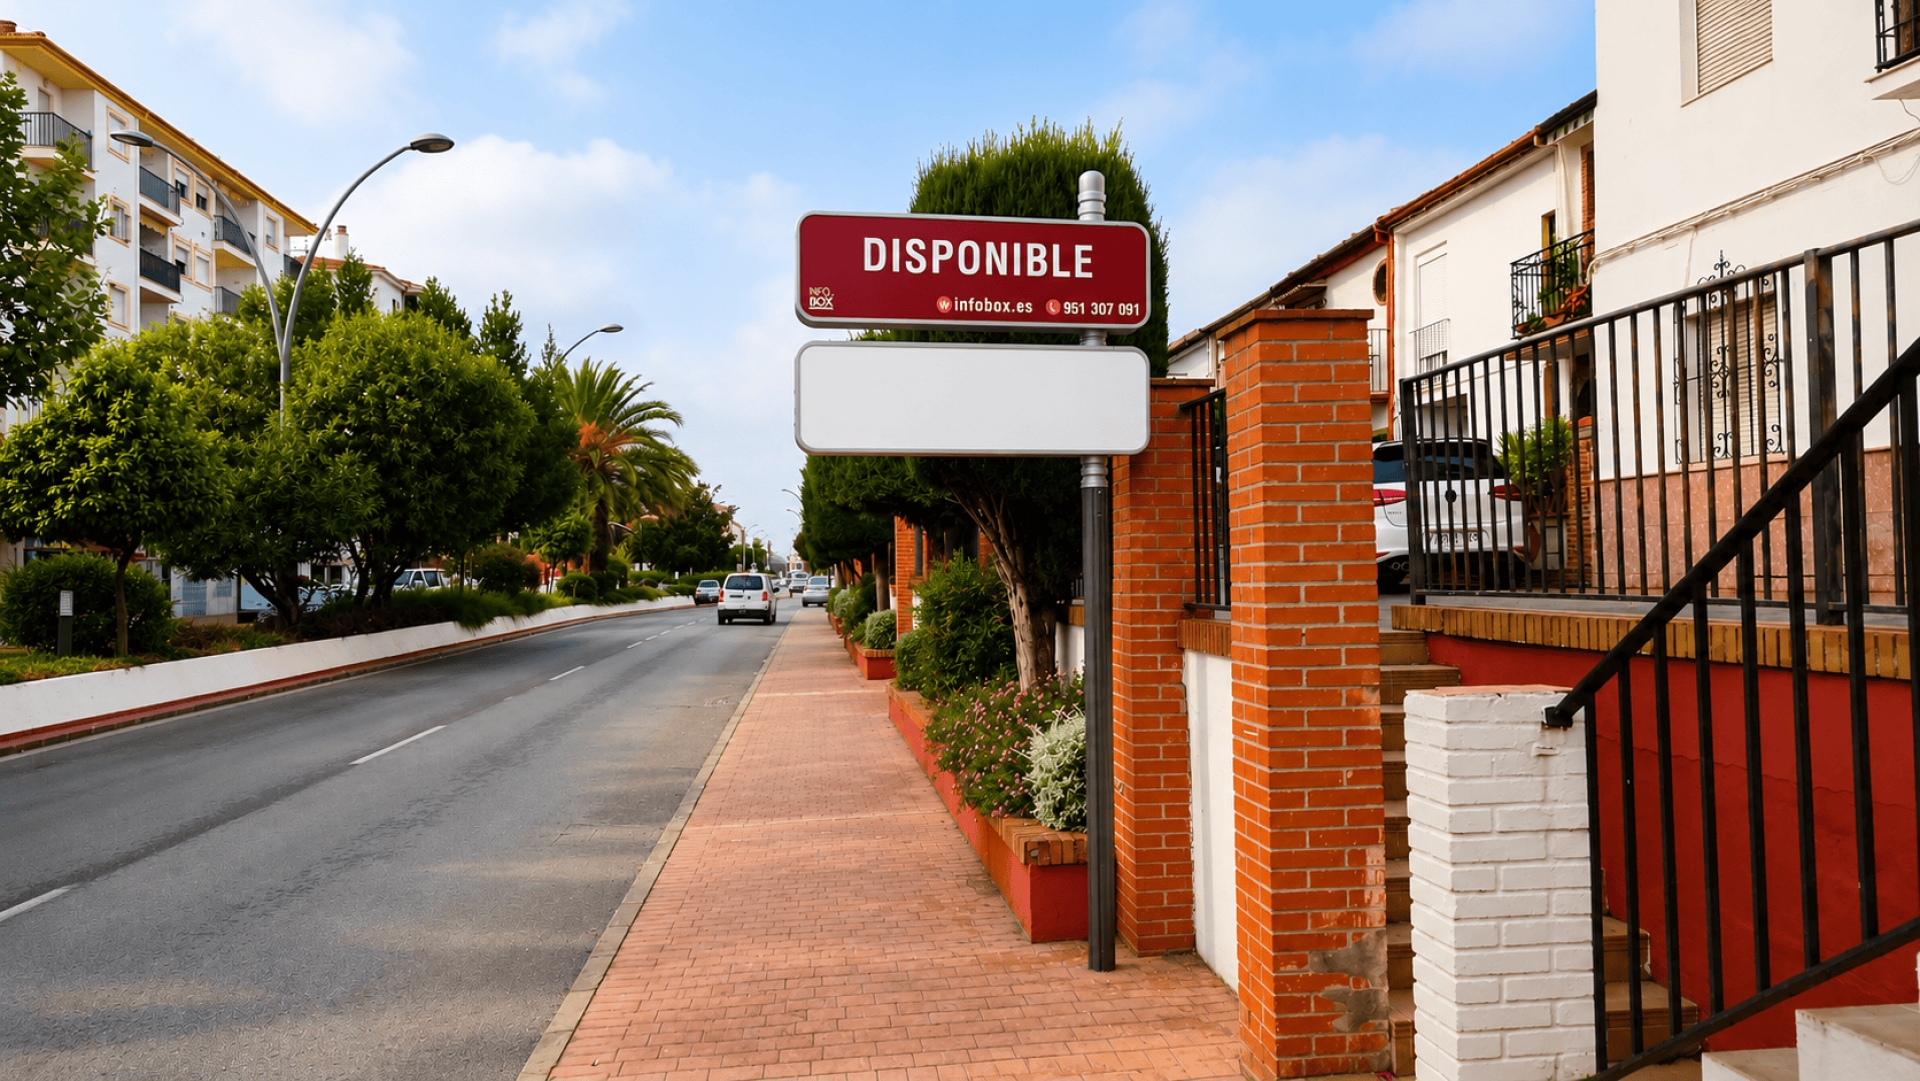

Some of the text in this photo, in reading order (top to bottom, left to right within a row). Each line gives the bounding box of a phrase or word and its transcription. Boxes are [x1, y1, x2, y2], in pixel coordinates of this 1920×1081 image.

[863, 236, 1093, 279] DISPONIBLE
[954, 296, 1034, 314] infobox.es
[1063, 301, 1140, 317] 951 307 091
